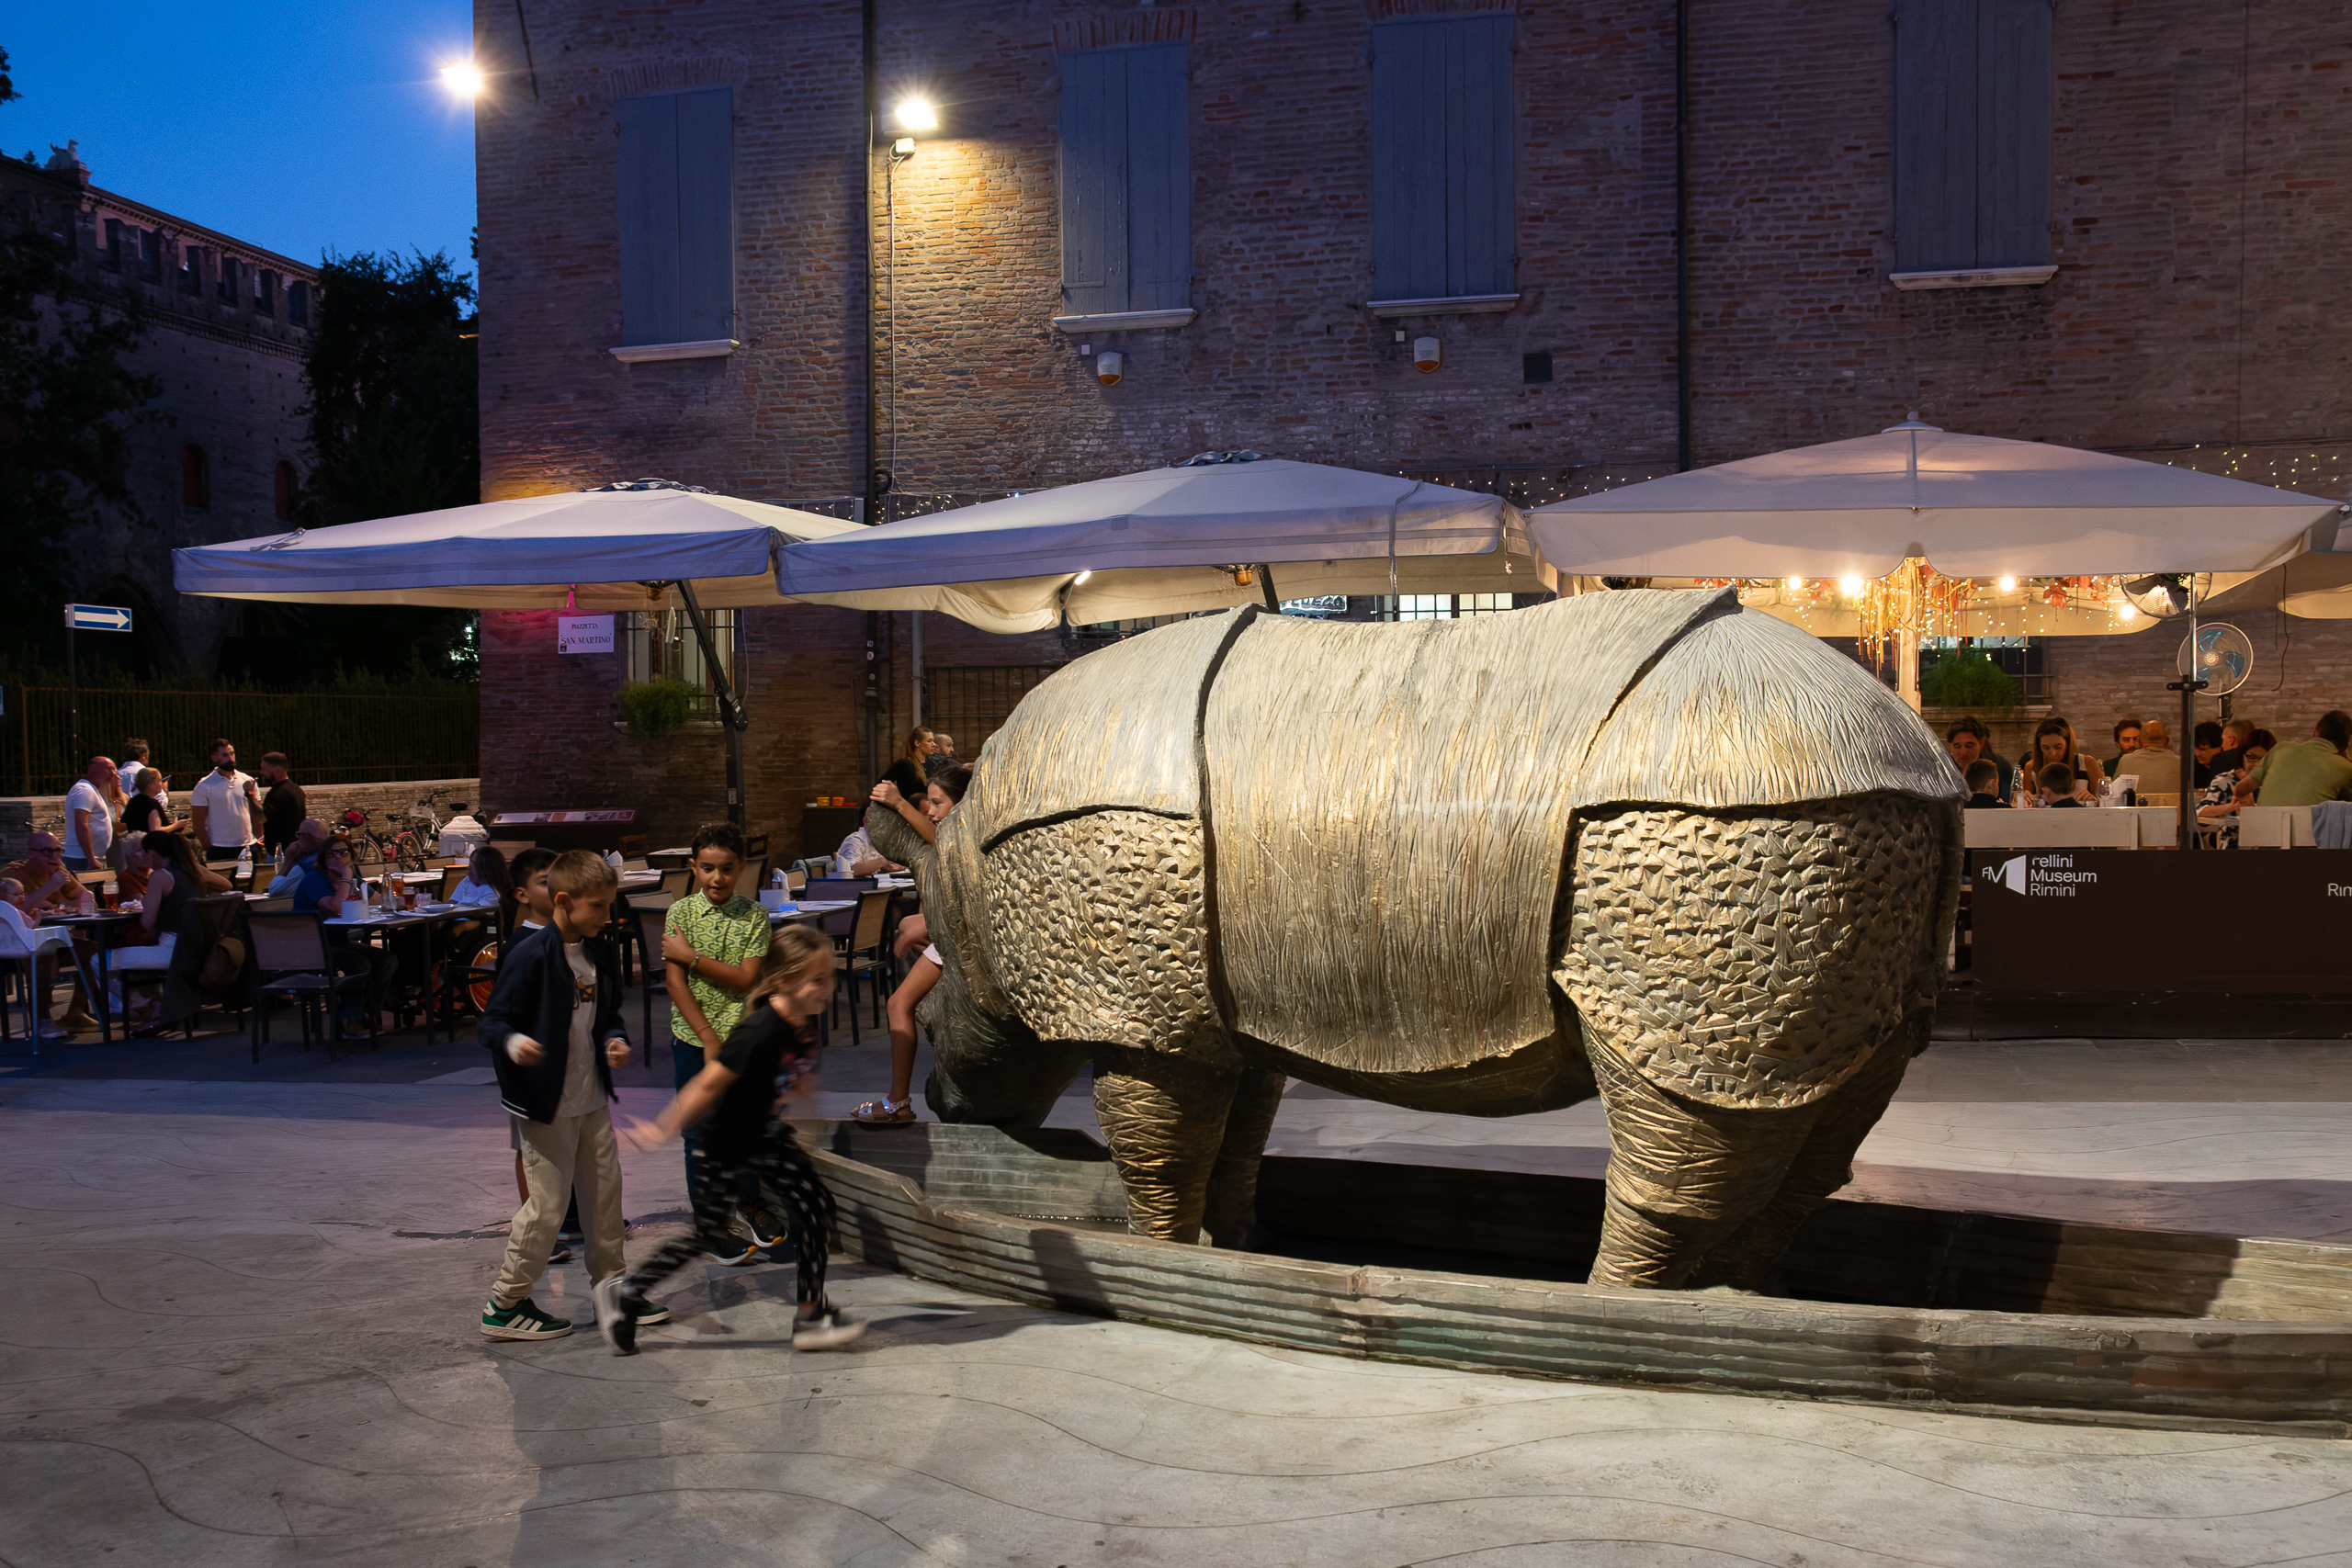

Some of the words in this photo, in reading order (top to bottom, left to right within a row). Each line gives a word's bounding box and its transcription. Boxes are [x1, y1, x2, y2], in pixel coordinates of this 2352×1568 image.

[560, 636, 576, 644] SAN
[578, 636, 611, 644] MARTINO
[2030, 869, 2098, 883] Museum
[2030, 884, 2075, 897] Rimini
